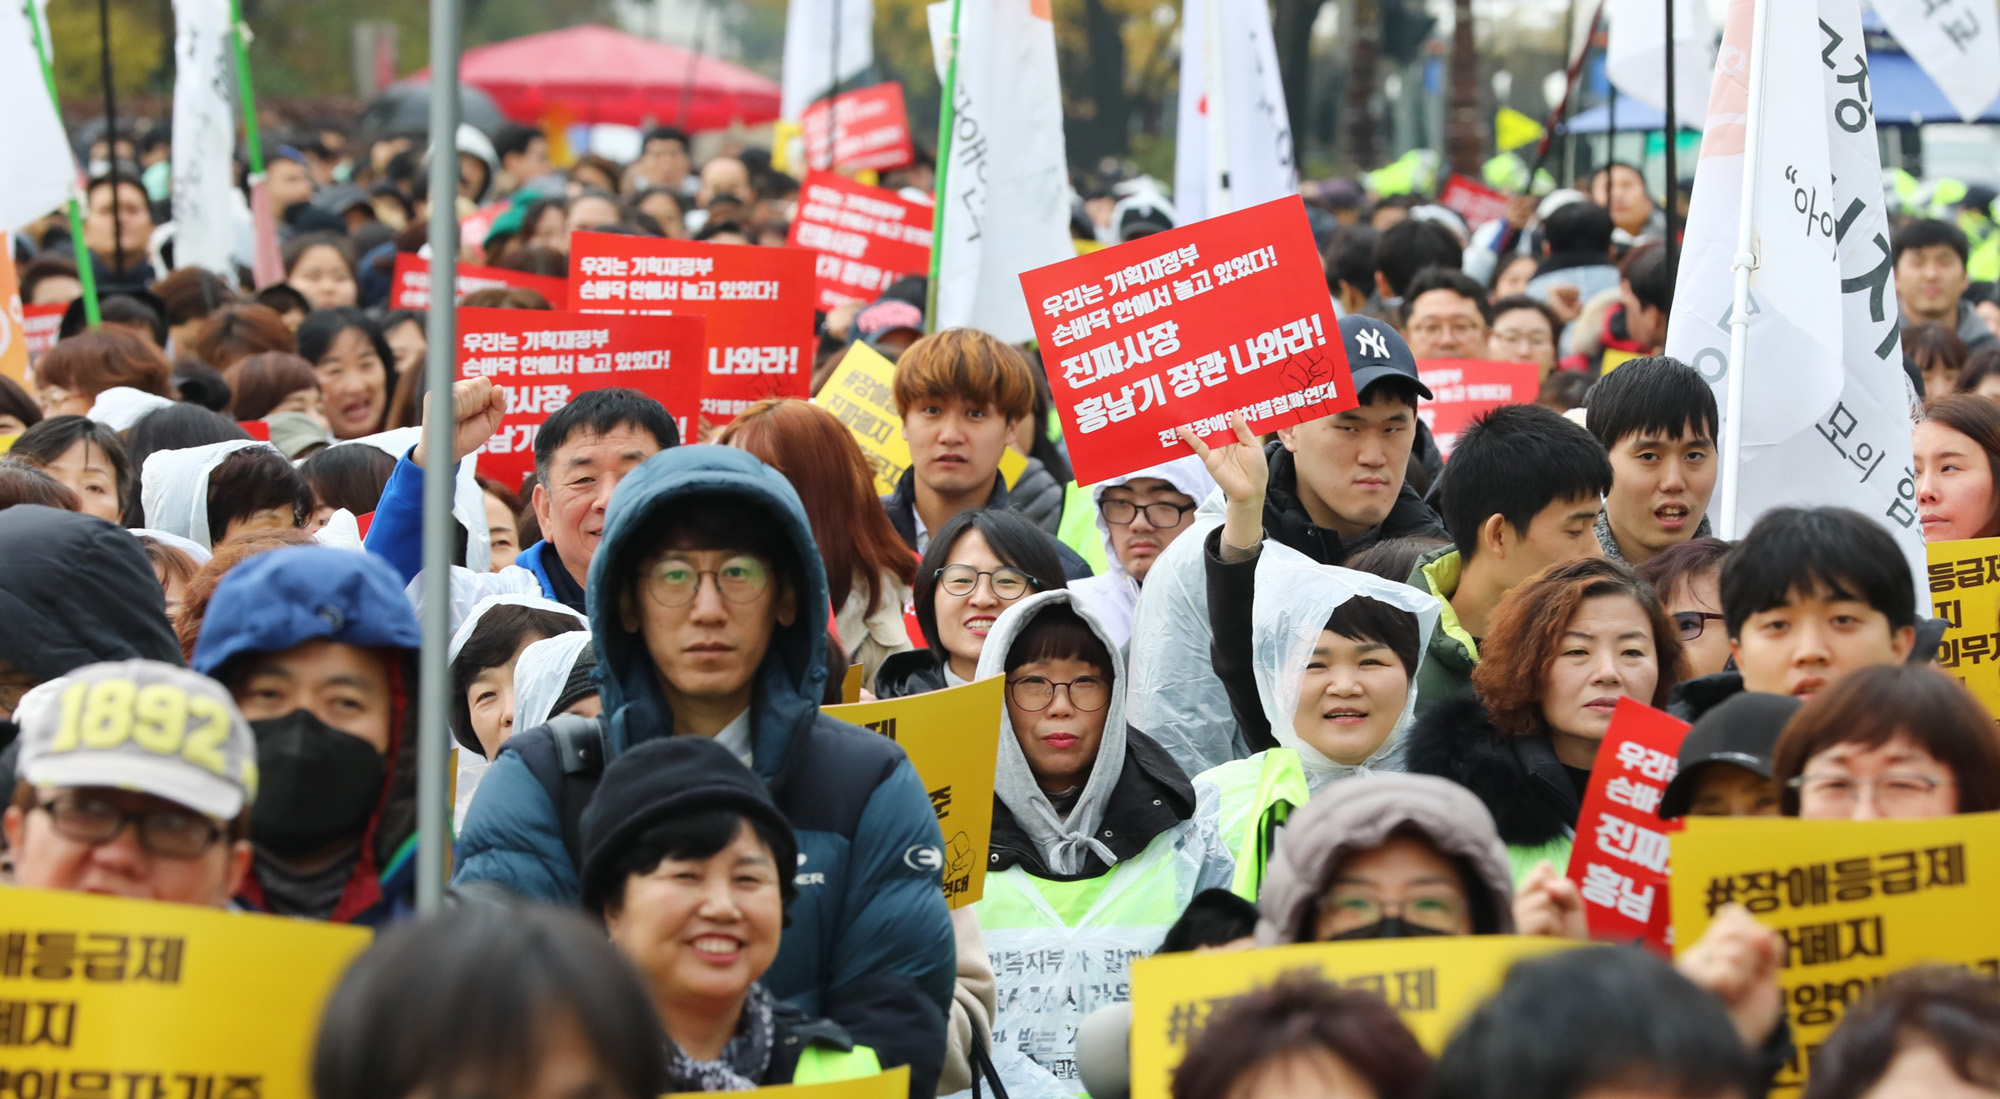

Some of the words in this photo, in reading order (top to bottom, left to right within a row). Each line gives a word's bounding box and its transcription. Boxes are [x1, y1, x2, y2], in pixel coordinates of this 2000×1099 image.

[580, 256, 629, 276] 우리는
[630, 256, 714, 277] 기획재정부
[1042, 283, 1103, 319] 우리는
[1104, 243, 1200, 297] 기획재정부
[579, 281, 628, 300] 손바닥
[629, 280, 678, 300] 안에서
[681, 281, 716, 300] 놀고
[718, 281, 779, 300] 있었다!
[1051, 308, 1111, 347] 손바닥
[1112, 285, 1173, 324] 안에서
[1173, 268, 1214, 302] 놀고
[1213, 245, 1279, 286] 있었다!
[463, 332, 518, 352] 우리는
[521, 329, 609, 351] 기획재정부
[1060, 320, 1181, 390] 진짜사장
[1355, 328, 1391, 359] NY
[462, 356, 518, 377] 손바닥
[520, 355, 574, 375] 안에서
[577, 353, 611, 374] 놀고
[615, 350, 671, 371] 있었다!
[708, 346, 799, 375] 나와라!
[1073, 374, 1167, 435] 홍남기
[1167, 351, 1228, 399] 장관
[1229, 313, 1327, 376] 나와라!
[53, 679, 231, 775] 1892
